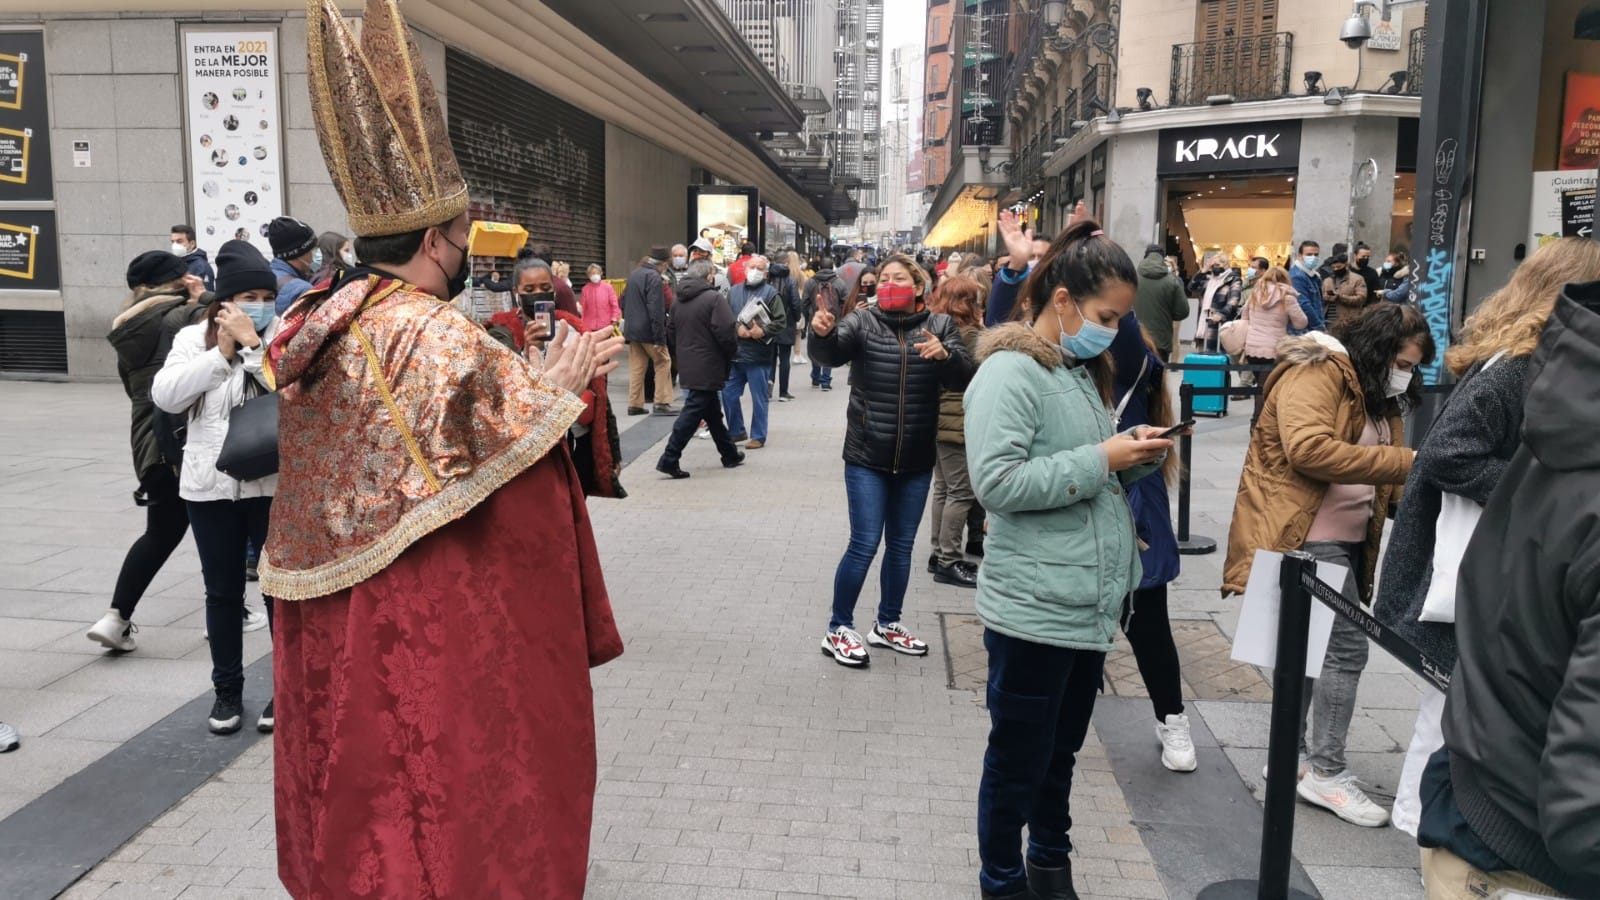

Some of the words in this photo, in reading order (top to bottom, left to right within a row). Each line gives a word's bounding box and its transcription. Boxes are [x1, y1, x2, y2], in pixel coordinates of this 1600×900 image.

[194, 45, 222, 53] ENTRA
[224, 45, 236, 53] EN
[238, 40, 268, 53] 2021
[194, 58, 207, 66] DE
[208, 58, 220, 66] LA
[221, 55, 268, 66] MEJOR
[195, 69, 232, 77] MANERA
[233, 69, 269, 77] POSIBLE
[1175, 133, 1280, 162] KRACK
